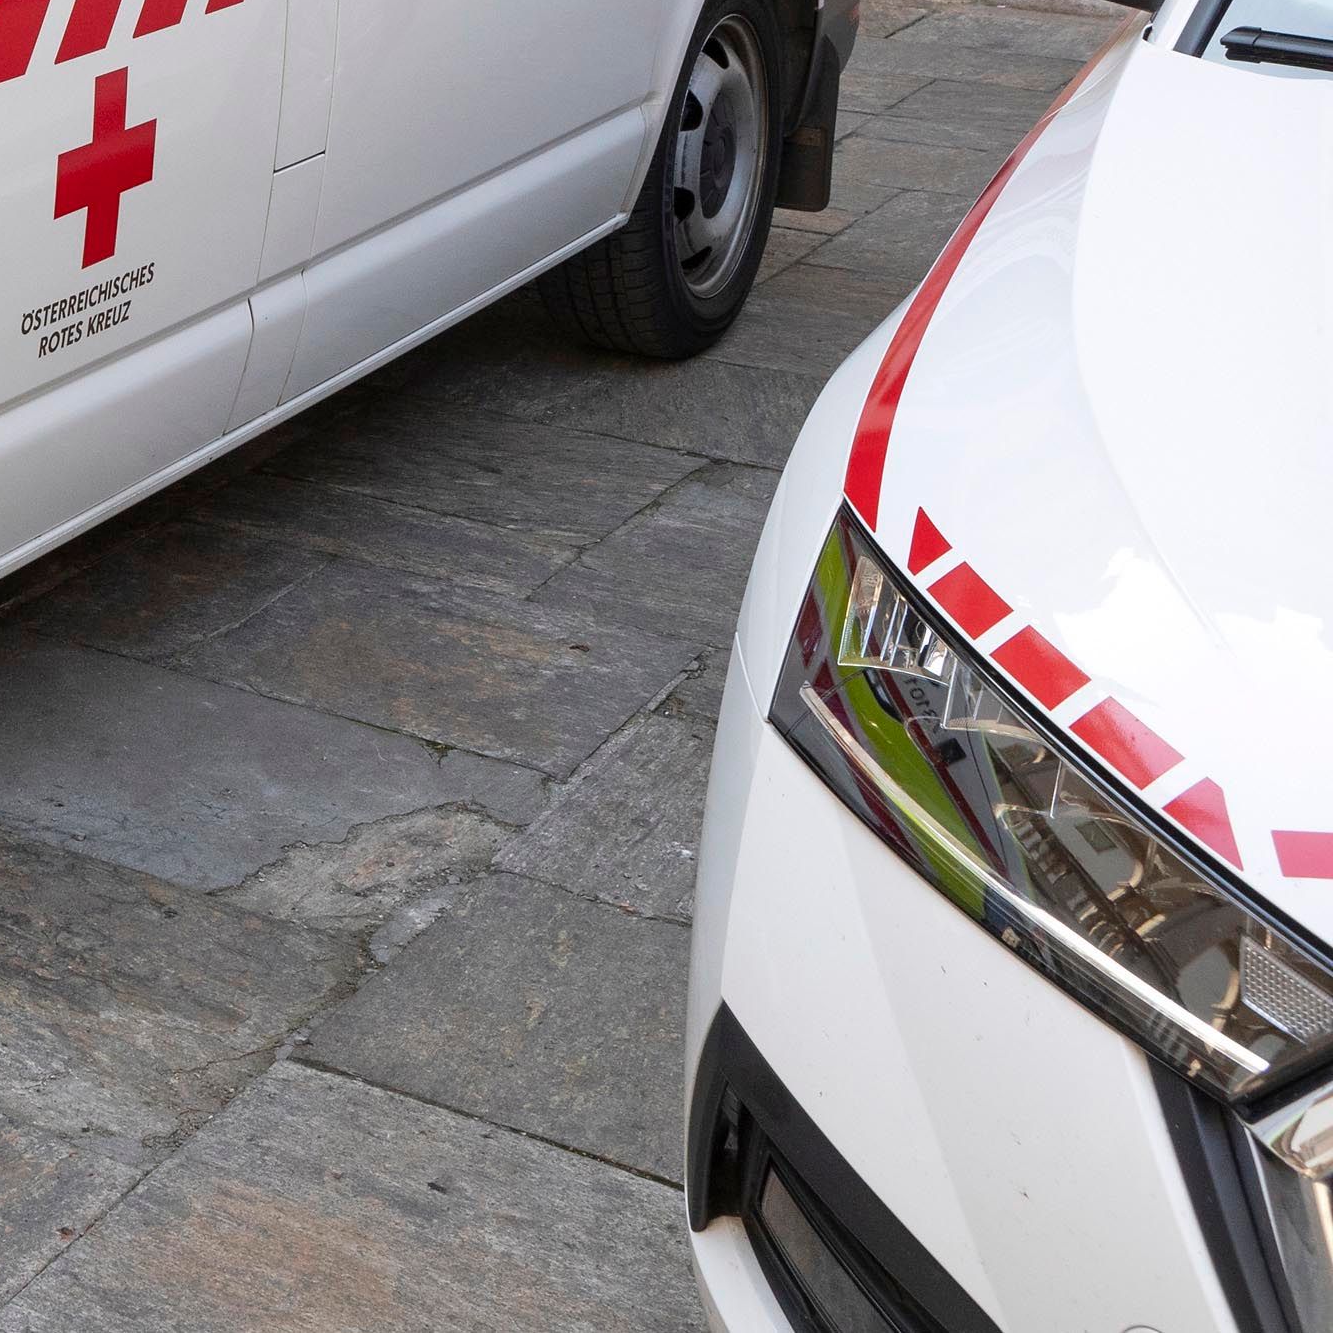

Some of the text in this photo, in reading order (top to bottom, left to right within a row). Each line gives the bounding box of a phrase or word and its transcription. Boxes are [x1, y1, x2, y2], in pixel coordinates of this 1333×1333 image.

[21, 262, 155, 335] ÖSTERREICHISCHES
[38, 300, 132, 359] ROTES KREUZ
